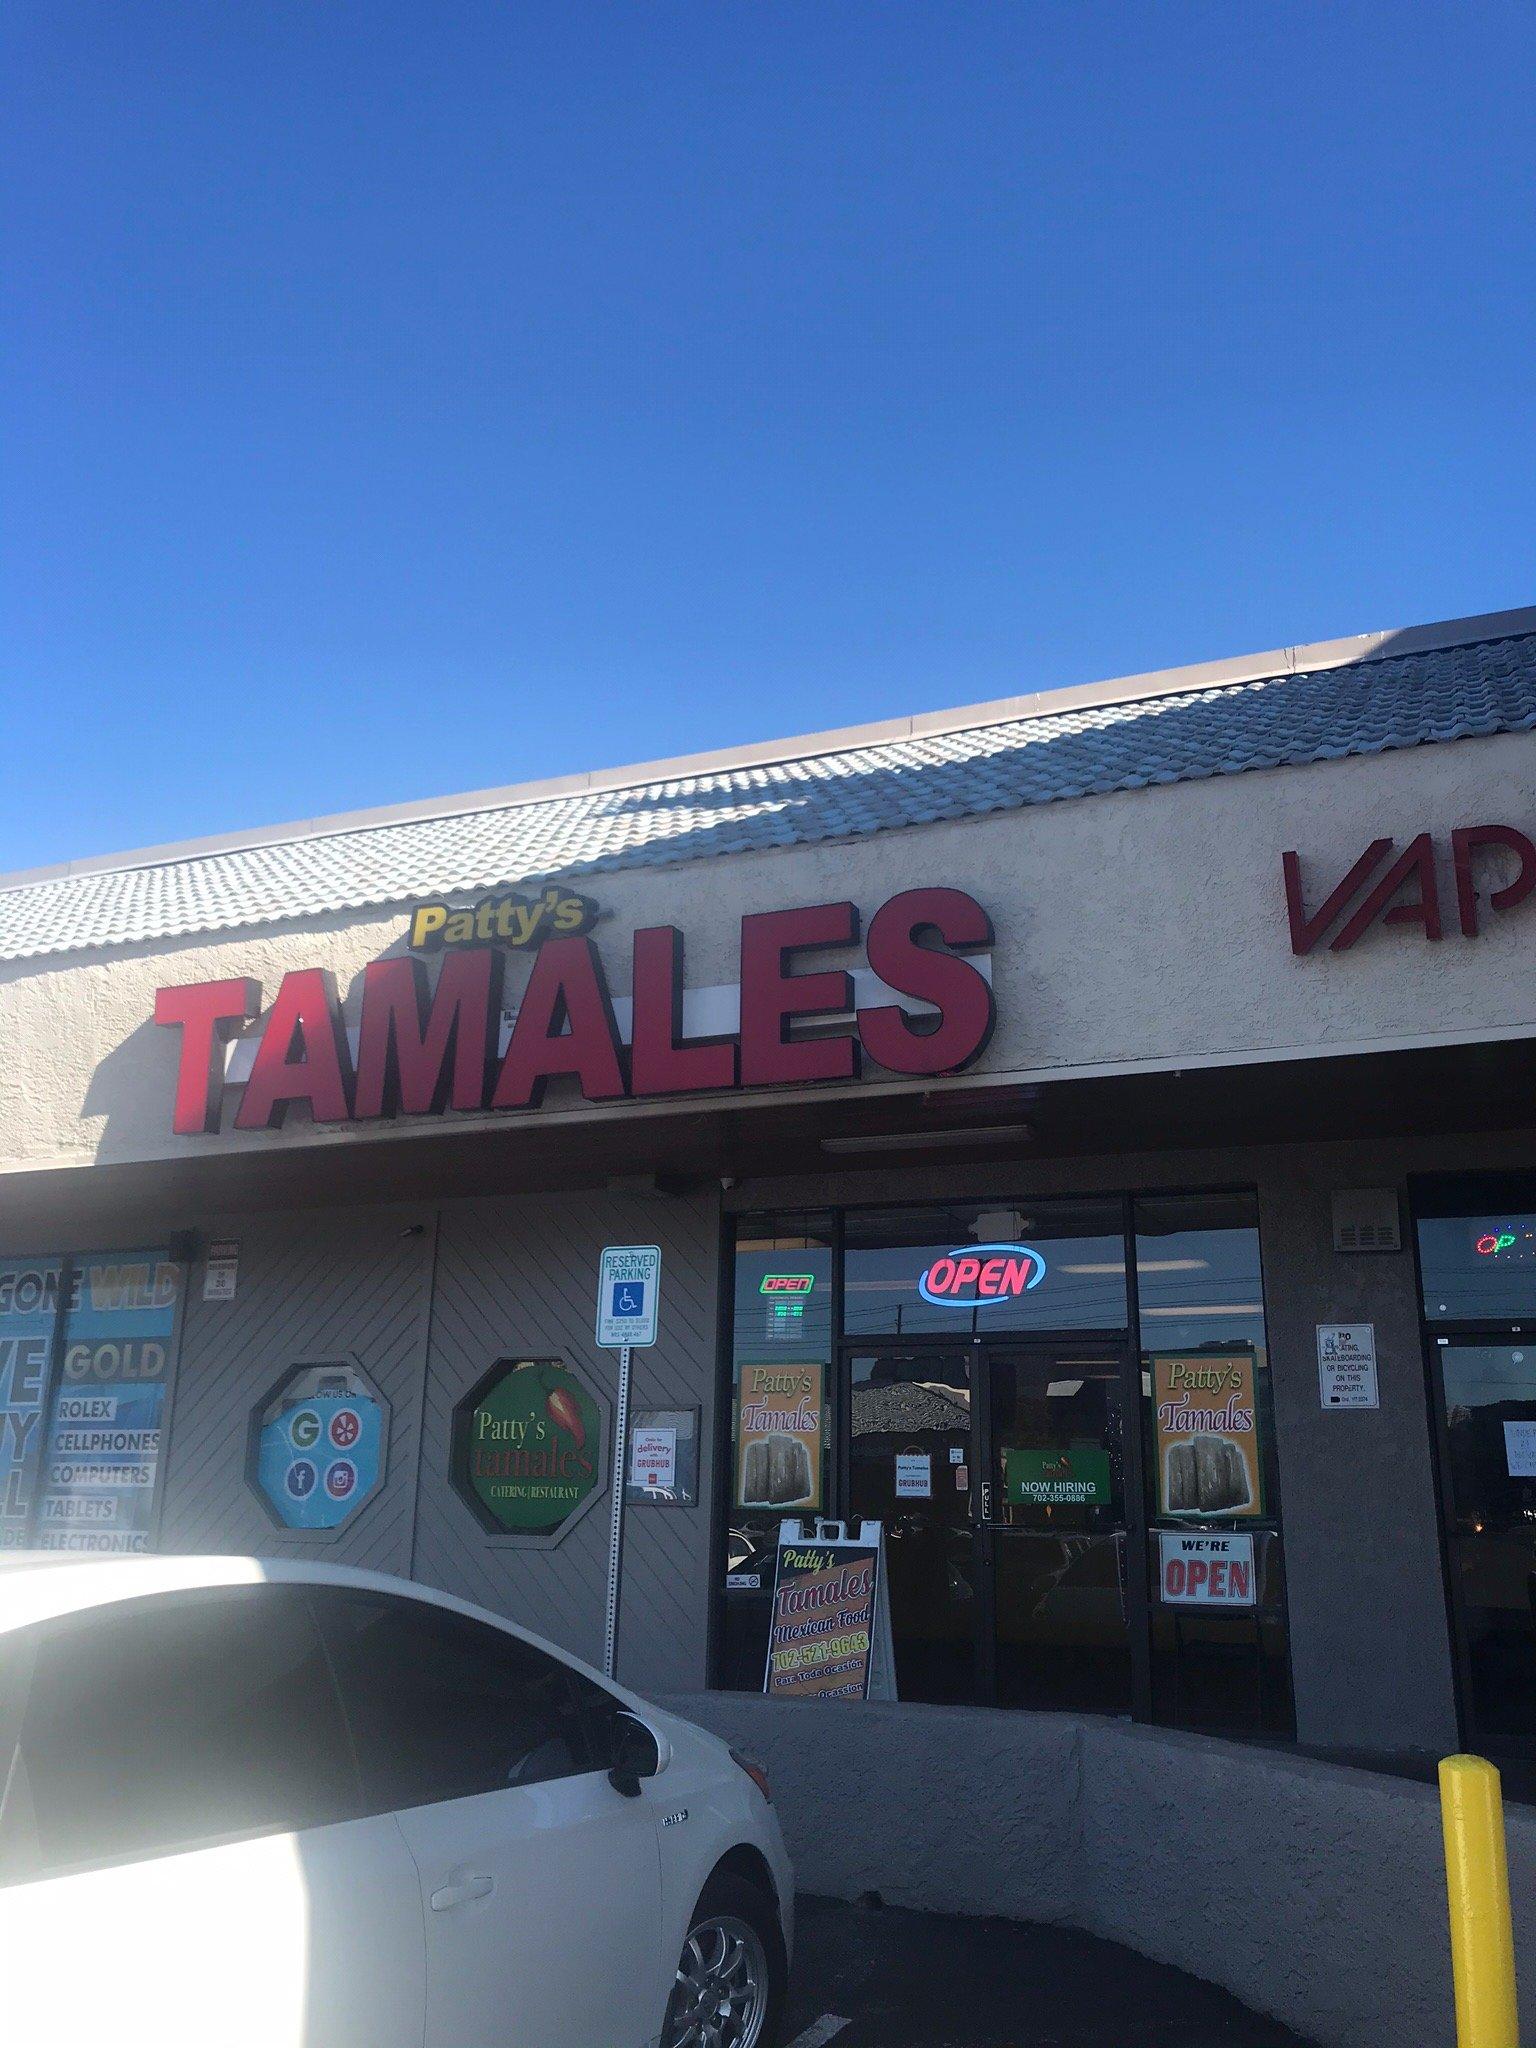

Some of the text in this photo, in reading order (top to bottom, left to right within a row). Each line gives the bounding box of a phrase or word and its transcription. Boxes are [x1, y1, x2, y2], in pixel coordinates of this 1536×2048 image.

[410, 889, 589, 948] Patty's
[154, 886, 997, 1135] TAMALES
[605, 1254, 656, 1269] RESERVED
[608, 1268, 651, 1281] PARKING
[764, 1278, 811, 1291] OPEN
[927, 1257, 1032, 1295] OPEN
[64, 1343, 166, 1380] GOLD
[750, 1367, 812, 1397] Patty's
[1168, 1362, 1243, 1394] Patty's
[1348, 1374, 1361, 1382] THIS
[59, 1400, 112, 1419] ROLEX
[741, 1396, 819, 1432] Tamales
[1158, 1392, 1254, 1432] Tamales
[55, 1432, 160, 1451] CELLPHONES
[478, 1412, 546, 1449] Patty's
[637, 1443, 672, 1455] delivery
[51, 1465, 150, 1484] COMPUTERS
[637, 1459, 670, 1468] GRUBHUB
[1021, 1482, 1096, 1492] NOW HIRING
[45, 1499, 113, 1517] TABLETS
[1181, 1540, 1230, 1552] WE'RE
[783, 1549, 836, 1575] Patty's
[1166, 1558, 1250, 1598] OPEN
[776, 1568, 874, 1617] Tamales
[774, 1602, 871, 1644] Mexican Food
[771, 1631, 870, 1672] 702-521-9643
[775, 1673, 797, 1687] Para
[799, 1667, 822, 1681] Toda
